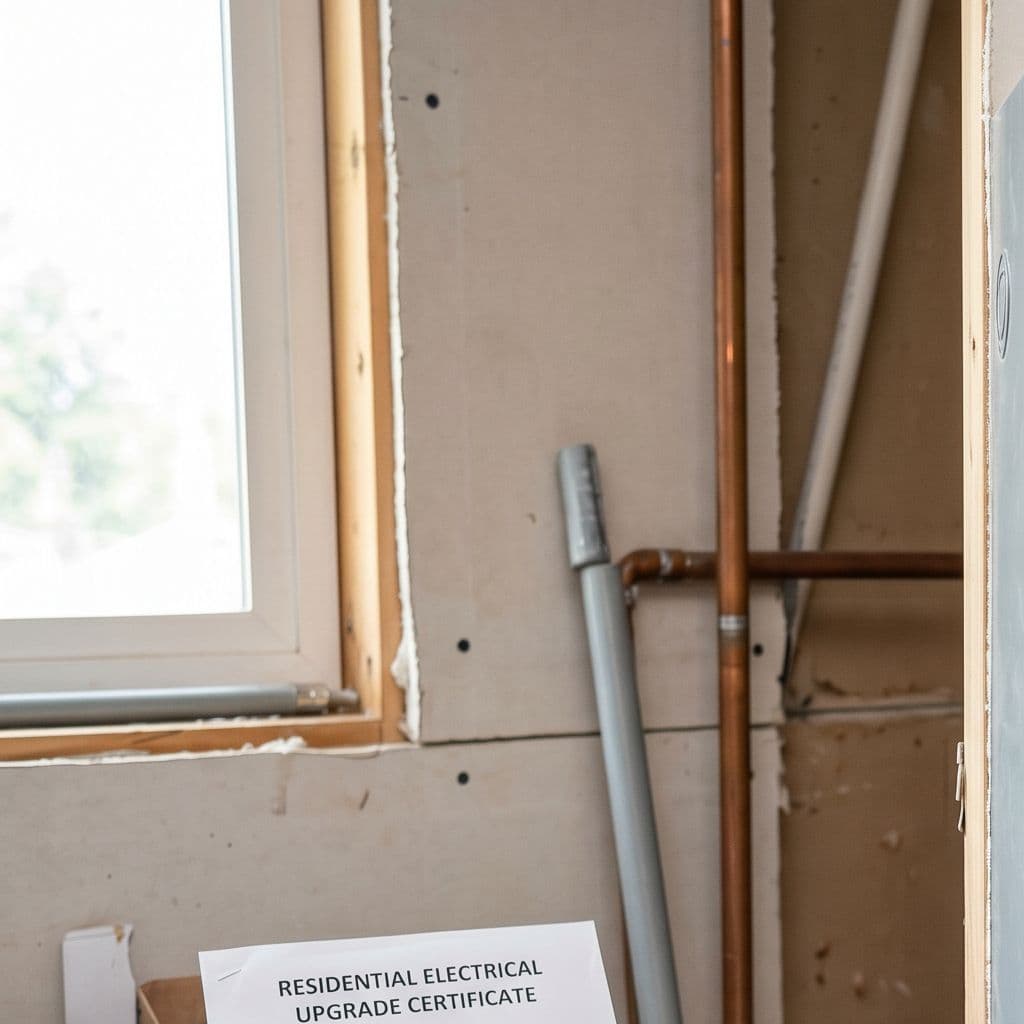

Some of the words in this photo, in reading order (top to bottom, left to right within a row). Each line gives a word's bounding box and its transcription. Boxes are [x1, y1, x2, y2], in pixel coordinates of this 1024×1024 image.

[278, 970, 418, 997] RESIDENTIAL
[423, 959, 543, 985] ELECTRICAL
[295, 998, 401, 1023] UPGRADE
[407, 986, 537, 1013] CERTIFICATE
